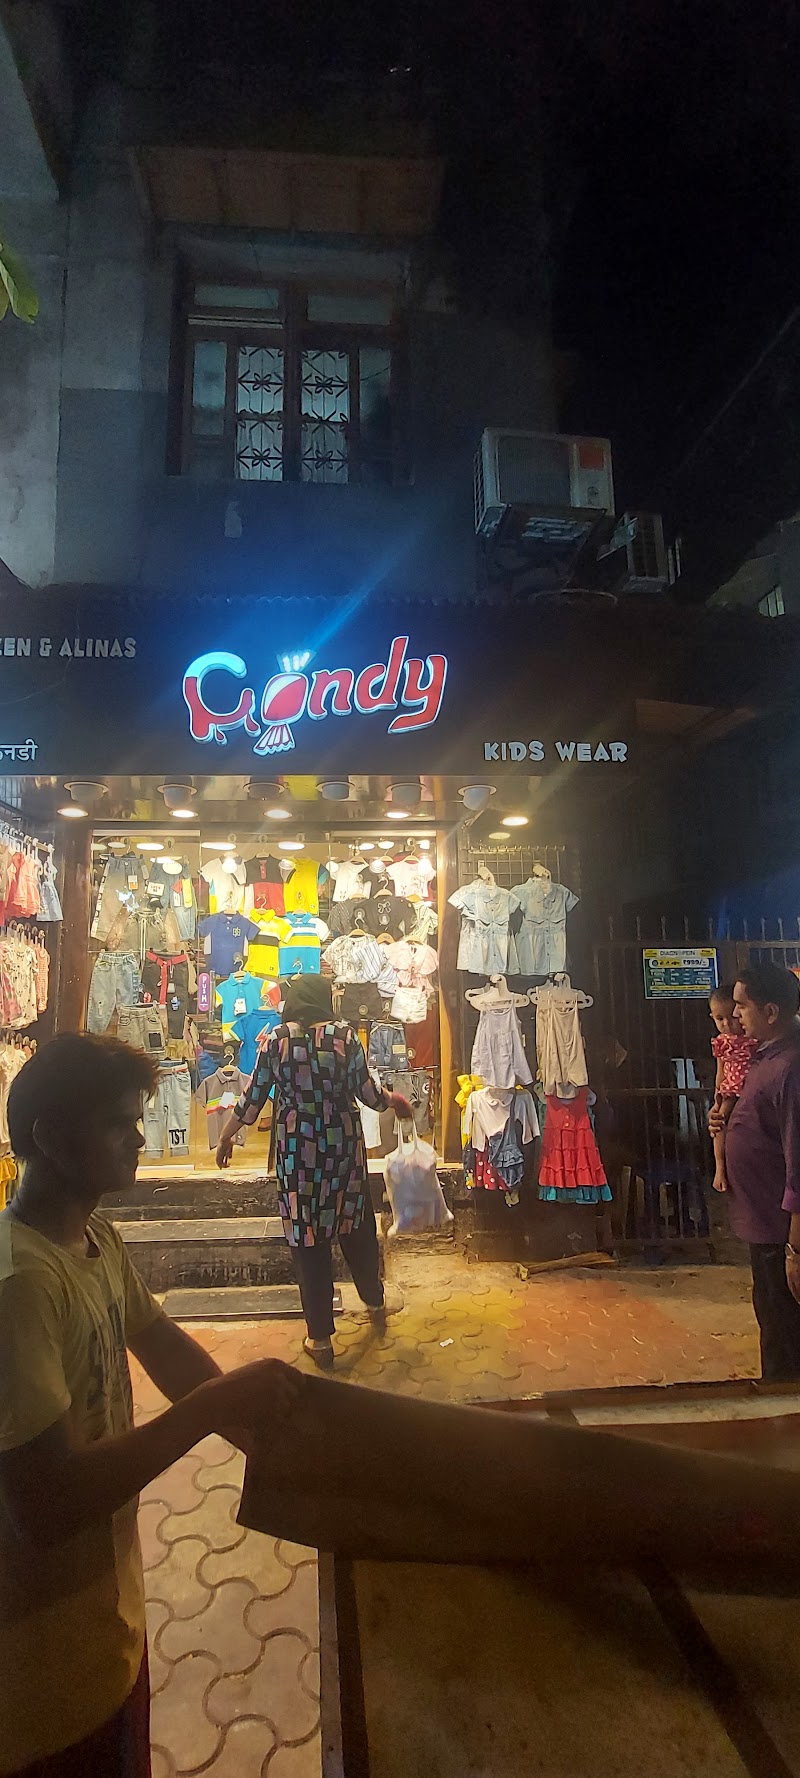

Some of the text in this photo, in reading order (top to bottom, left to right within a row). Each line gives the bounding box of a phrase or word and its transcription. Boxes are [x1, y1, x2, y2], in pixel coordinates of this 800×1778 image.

[39, 637, 52, 657] &
[59, 637, 137, 659] ALINAS
[484, 740, 628, 763] KIDS WEAR
[168, 1128, 187, 1146] TST
